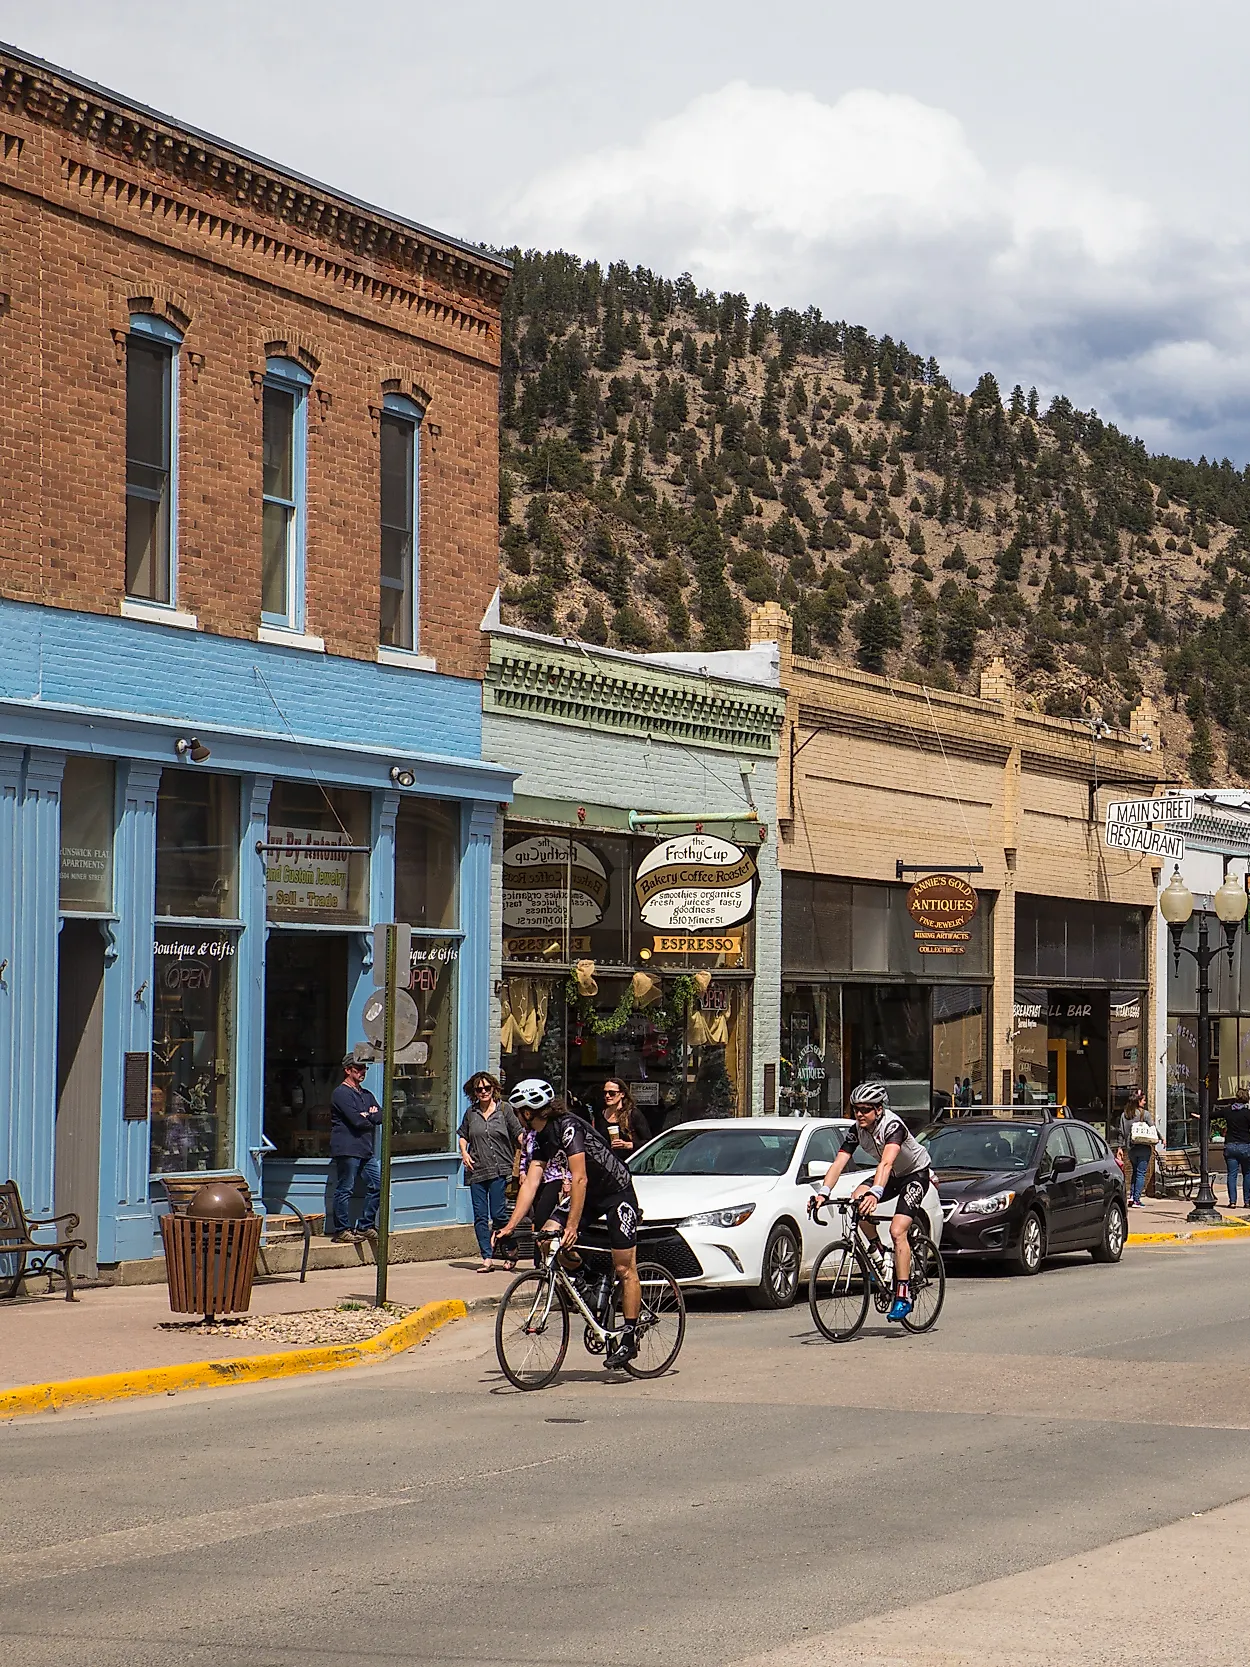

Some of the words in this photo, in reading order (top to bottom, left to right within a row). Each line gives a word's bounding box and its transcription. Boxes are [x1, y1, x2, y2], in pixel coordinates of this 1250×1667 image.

[1117, 803, 1150, 822] MAIN
[1152, 800, 1190, 819] STREET
[692, 836, 705, 846] the
[1109, 823, 1182, 856] RESTAURANT
[62, 858, 105, 870] APARTMENTS
[283, 865, 314, 886] Custom
[315, 867, 347, 890] Jewelry
[640, 872, 678, 896] Bakery
[679, 870, 714, 883] Coffee
[716, 860, 750, 883] Roaster
[913, 877, 947, 897] ANNIE'S
[947, 878, 972, 896] GOLD
[275, 889, 297, 906] Sell
[306, 891, 339, 907] Trade
[659, 890, 698, 899] smoothies
[700, 890, 742, 901] organics
[649, 899, 674, 907] fresh
[683, 899, 711, 908] juices
[719, 899, 743, 909] tasty
[911, 899, 974, 912] ANTIQUES
[673, 906, 716, 917] goodness
[668, 916, 687, 925] 1510
[688, 916, 714, 925] Miner
[918, 916, 935, 928] FINE
[933, 915, 965, 929] JEWELRY
[936, 932, 969, 940] ARTIFACTS
[153, 940, 196, 960] Boutique
[197, 941, 210, 956] &
[209, 940, 236, 961] Gifts
[660, 938, 734, 951] ESPRESSO
[427, 948, 438, 961] &
[437, 946, 459, 965] Gifts
[167, 968, 212, 989] OPEN
[1066, 1004, 1092, 1017] BAR
[797, 1067, 826, 1080] ANTIQUES
